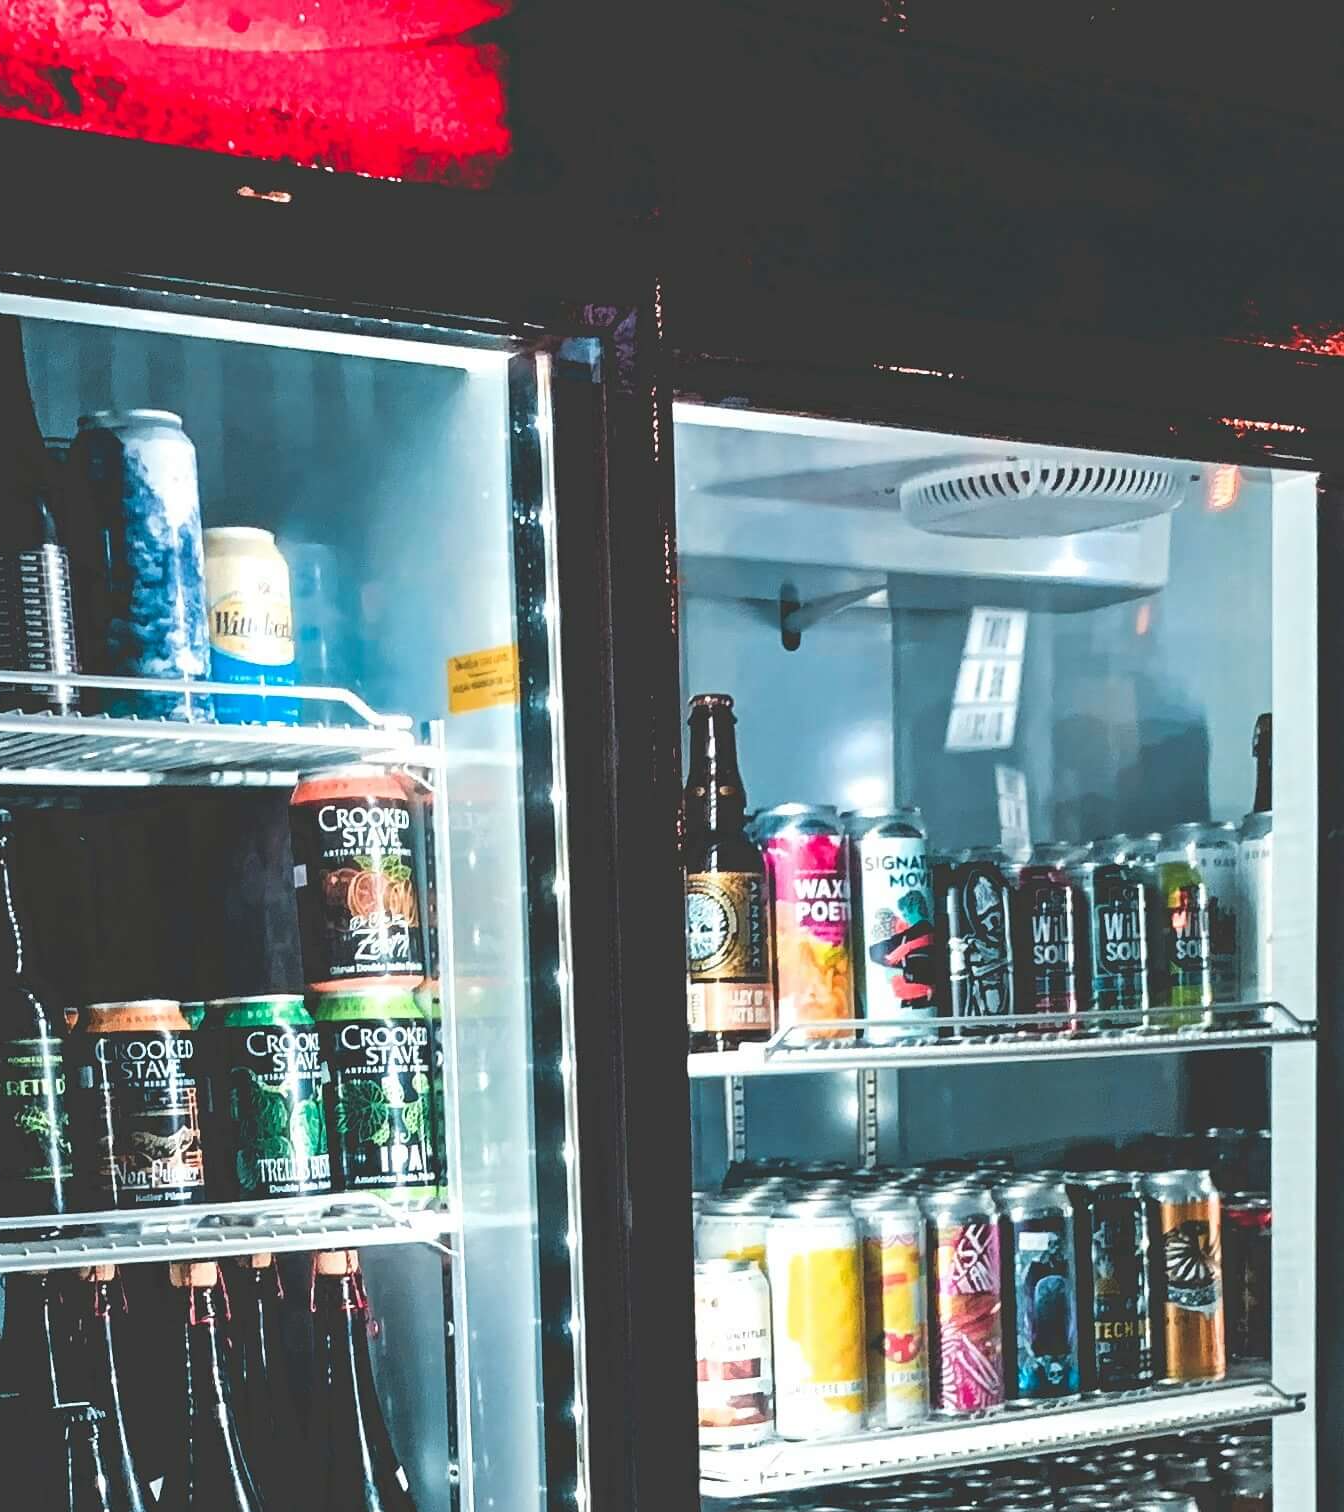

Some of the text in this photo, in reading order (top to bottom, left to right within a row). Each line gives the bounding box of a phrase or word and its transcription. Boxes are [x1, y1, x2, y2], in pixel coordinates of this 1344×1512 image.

[318, 805, 410, 832] CROOKED
[342, 827, 403, 848] STAVE
[340, 1024, 428, 1051] CROOKED
[366, 1047, 424, 1066] STAVE
[120, 1059, 186, 1080] STAVE
[380, 1144, 426, 1173] IPA
